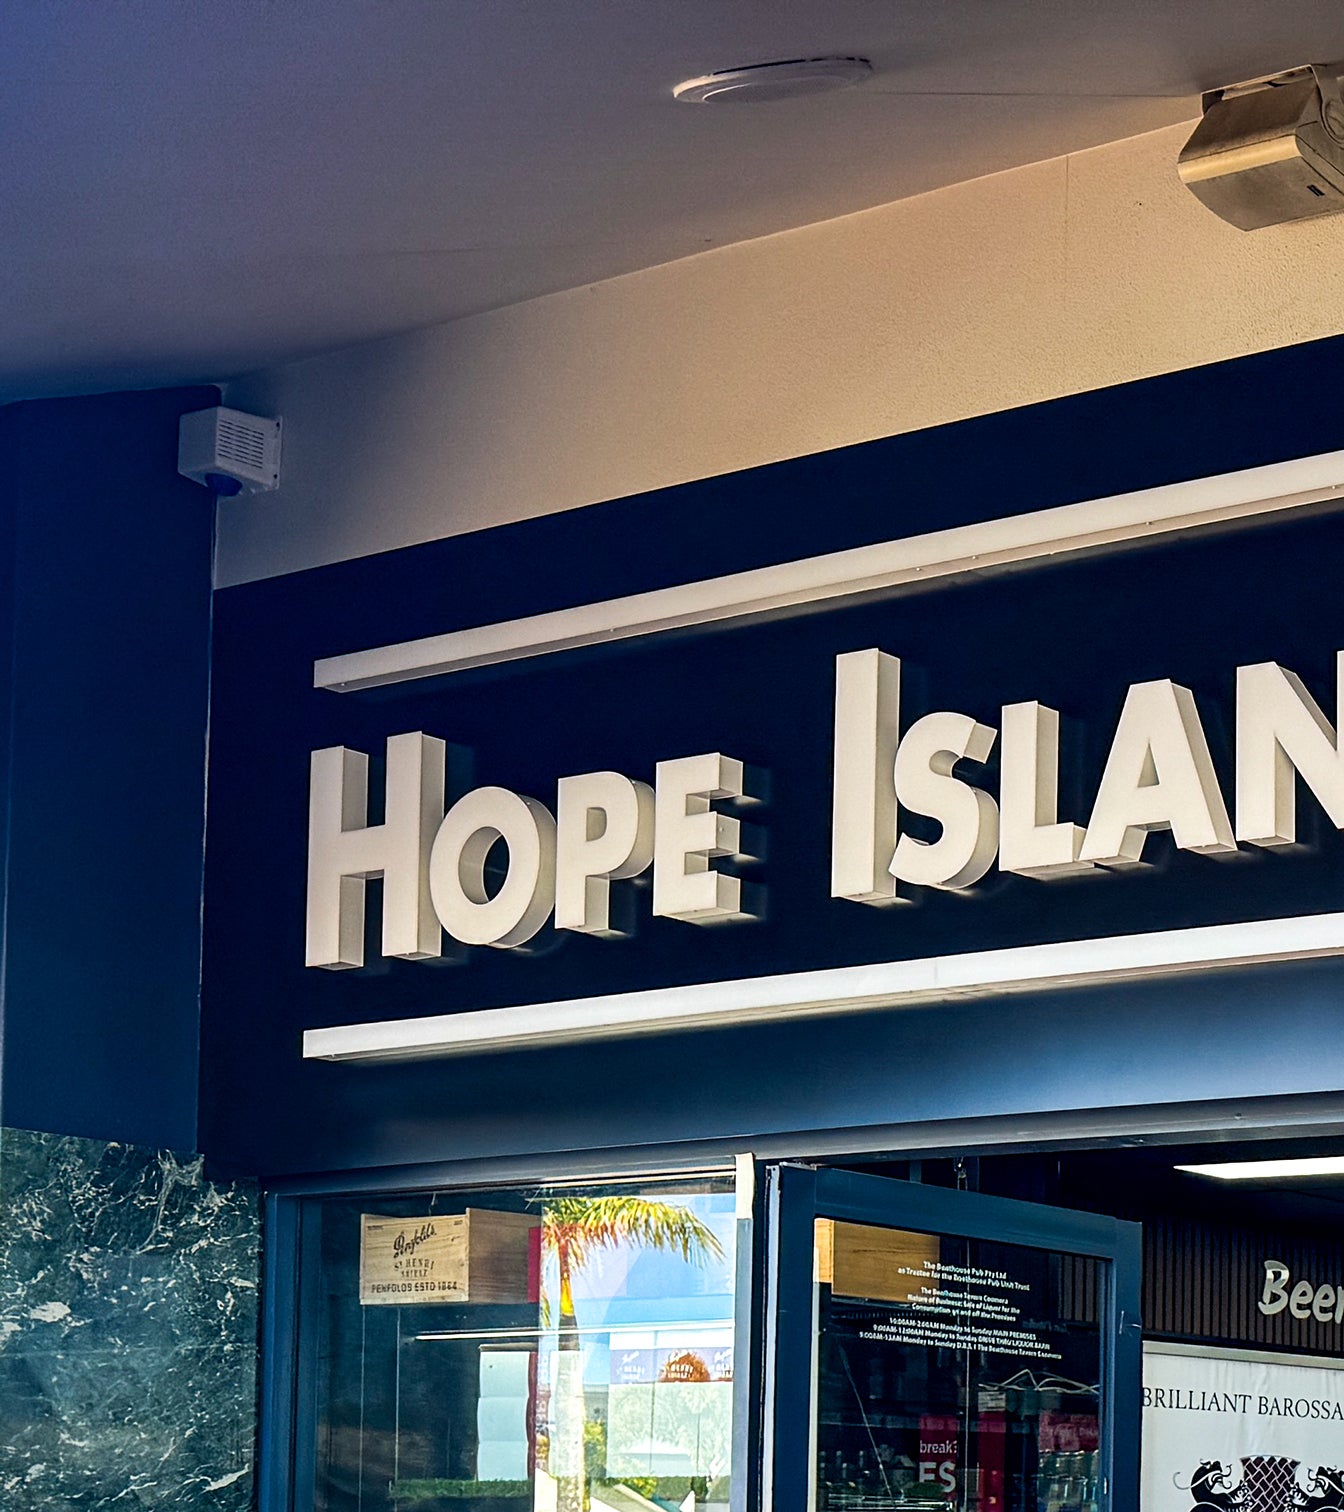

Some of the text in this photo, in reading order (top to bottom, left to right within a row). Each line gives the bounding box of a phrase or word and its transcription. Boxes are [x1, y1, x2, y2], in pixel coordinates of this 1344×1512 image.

[306, 731, 745, 969] HOPE
[1142, 1387, 1251, 1415] BRILLIANT
[1257, 1396, 1344, 1422] BAROSSA
